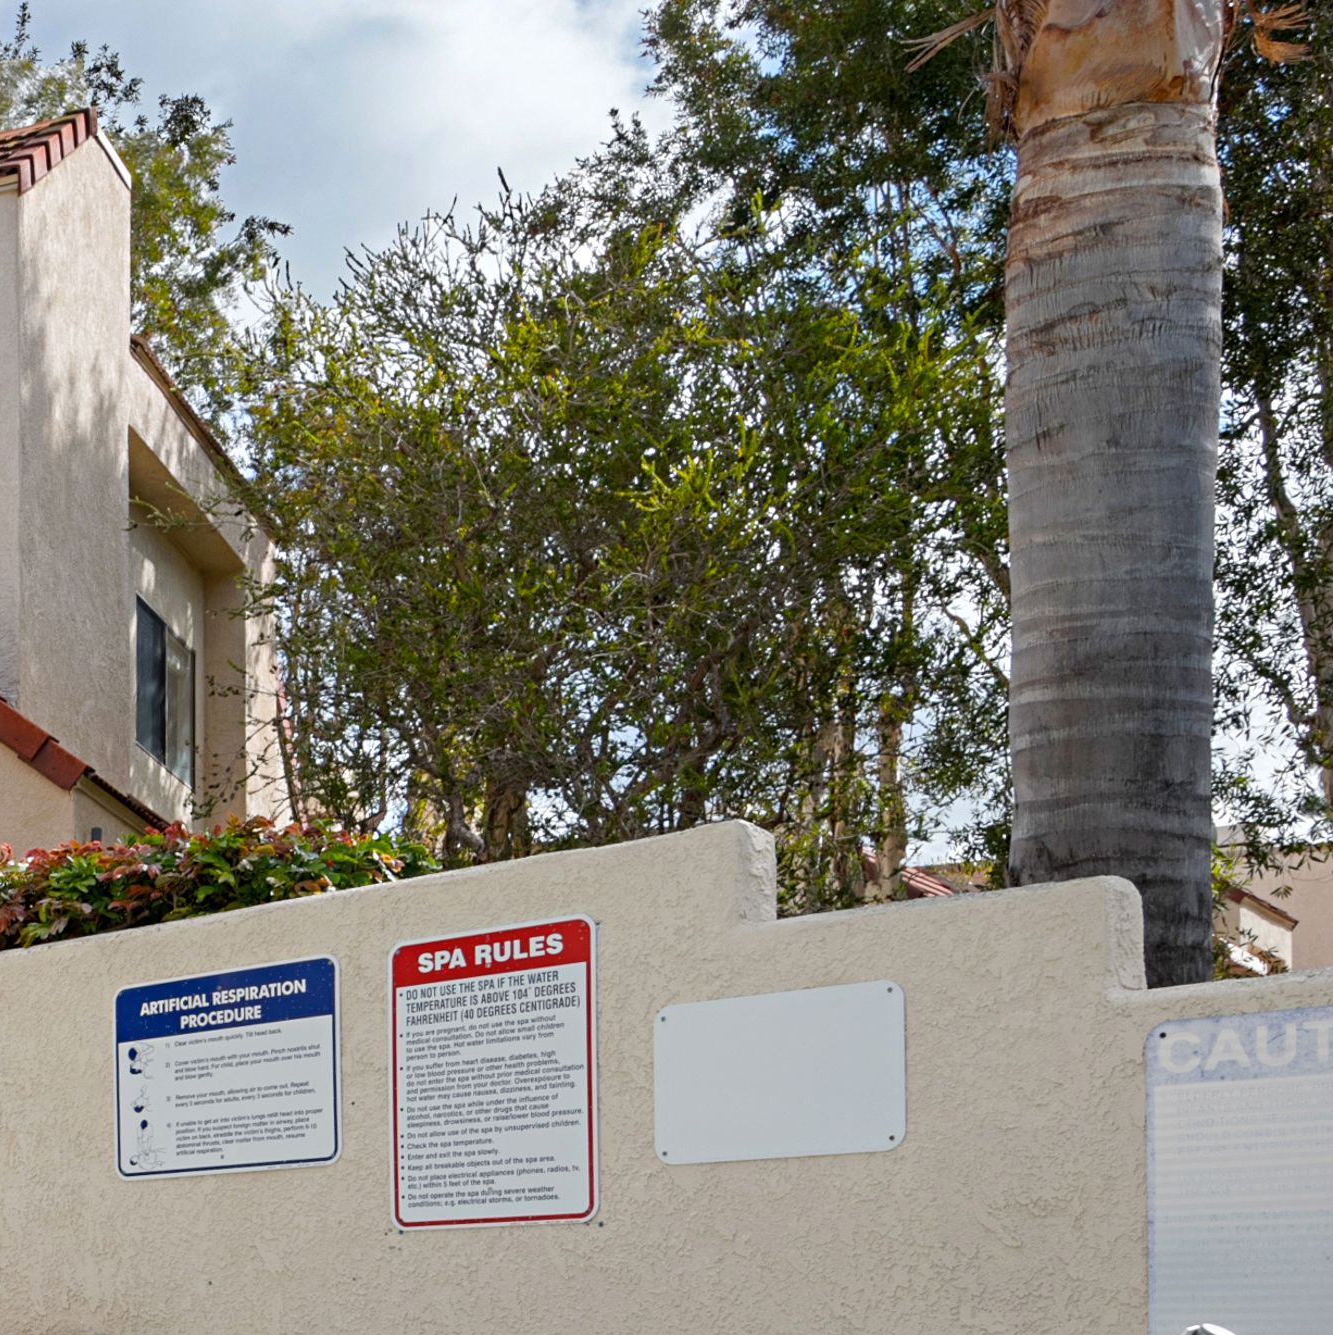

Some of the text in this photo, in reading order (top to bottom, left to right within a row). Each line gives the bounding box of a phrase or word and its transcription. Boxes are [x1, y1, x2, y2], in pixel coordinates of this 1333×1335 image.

[418, 934, 563, 973] SPA RULES
[140, 979, 306, 1016] ARTIFICIAL RESPIRATION
[406, 970, 558, 1000] DO NOT USE THE SPA IF THE WATER
[406, 996, 466, 1013] TEMPERATURE
[469, 994, 478, 1005] IS
[481, 990, 509, 1004] ABOVE
[534, 982, 575, 997] DEGREES
[180, 1005, 261, 1029] PROCEDURE
[406, 1010, 457, 1027] FAHRENHEIT
[476, 1003, 516, 1018] DEGREES
